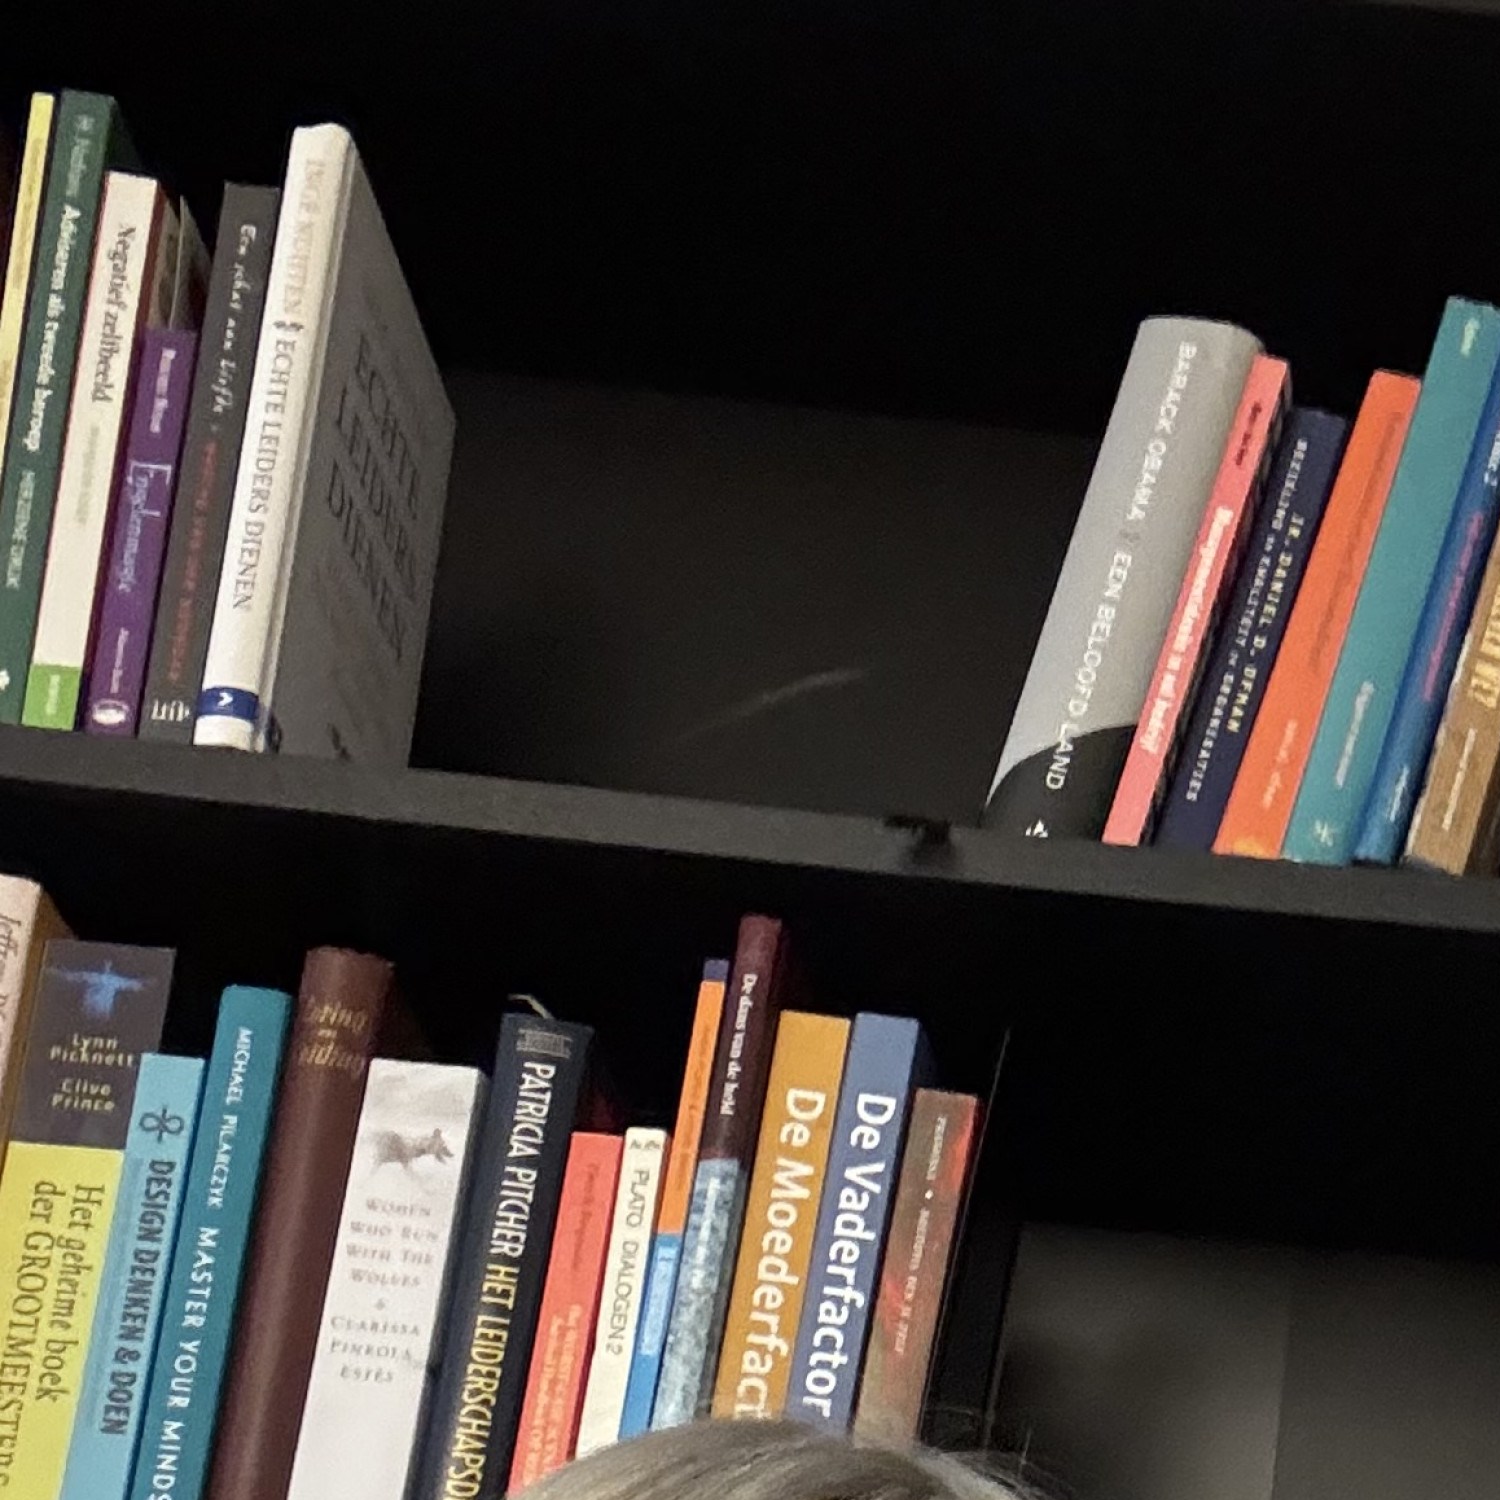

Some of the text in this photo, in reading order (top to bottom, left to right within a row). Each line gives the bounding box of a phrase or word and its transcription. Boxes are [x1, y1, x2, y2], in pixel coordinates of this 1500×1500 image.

[235, 222, 257, 257] Een
[89, 222, 140, 404] Negatief zelfbeeld
[20, 386, 52, 452] beroep
[230, 335, 297, 612] ECHTE LEIDERS DIENEN
[1123, 338, 1199, 526] BARACK OBAMA
[1268, 435, 1309, 532] BEZIELING
[1231, 553, 1273, 648] KWALITEIT
[1257, 550, 1293, 629] DANIEL
[1040, 547, 1134, 793] EEN BELOOFD LAND
[1183, 669, 1237, 805] ORGANISATIES
[1224, 664, 1257, 735] OFMAN
[739, 971, 758, 996] De
[51, 1093, 116, 1112] Prince
[61, 1078, 112, 1097] Clive
[205, 1027, 254, 1211] MICHAEL PILARCZYK
[482, 1057, 562, 1261] PATRICIA PITCHER
[32, 1177, 107, 1407] Het geheime boek
[99, 1157, 176, 1439] DESIGN DENKEN & DOEN
[179, 1225, 221, 1331] MASTER
[478, 1262, 520, 1310] HET
[604, 1167, 651, 1357] PLATO DIALOGEN 2
[730, 1085, 827, 1424] De Moederfact
[798, 1089, 897, 1421] De Vaderfactor
[0, 1179, 68, 1490] der GROOTMEESTE
[164, 1335, 201, 1412] YOUR
